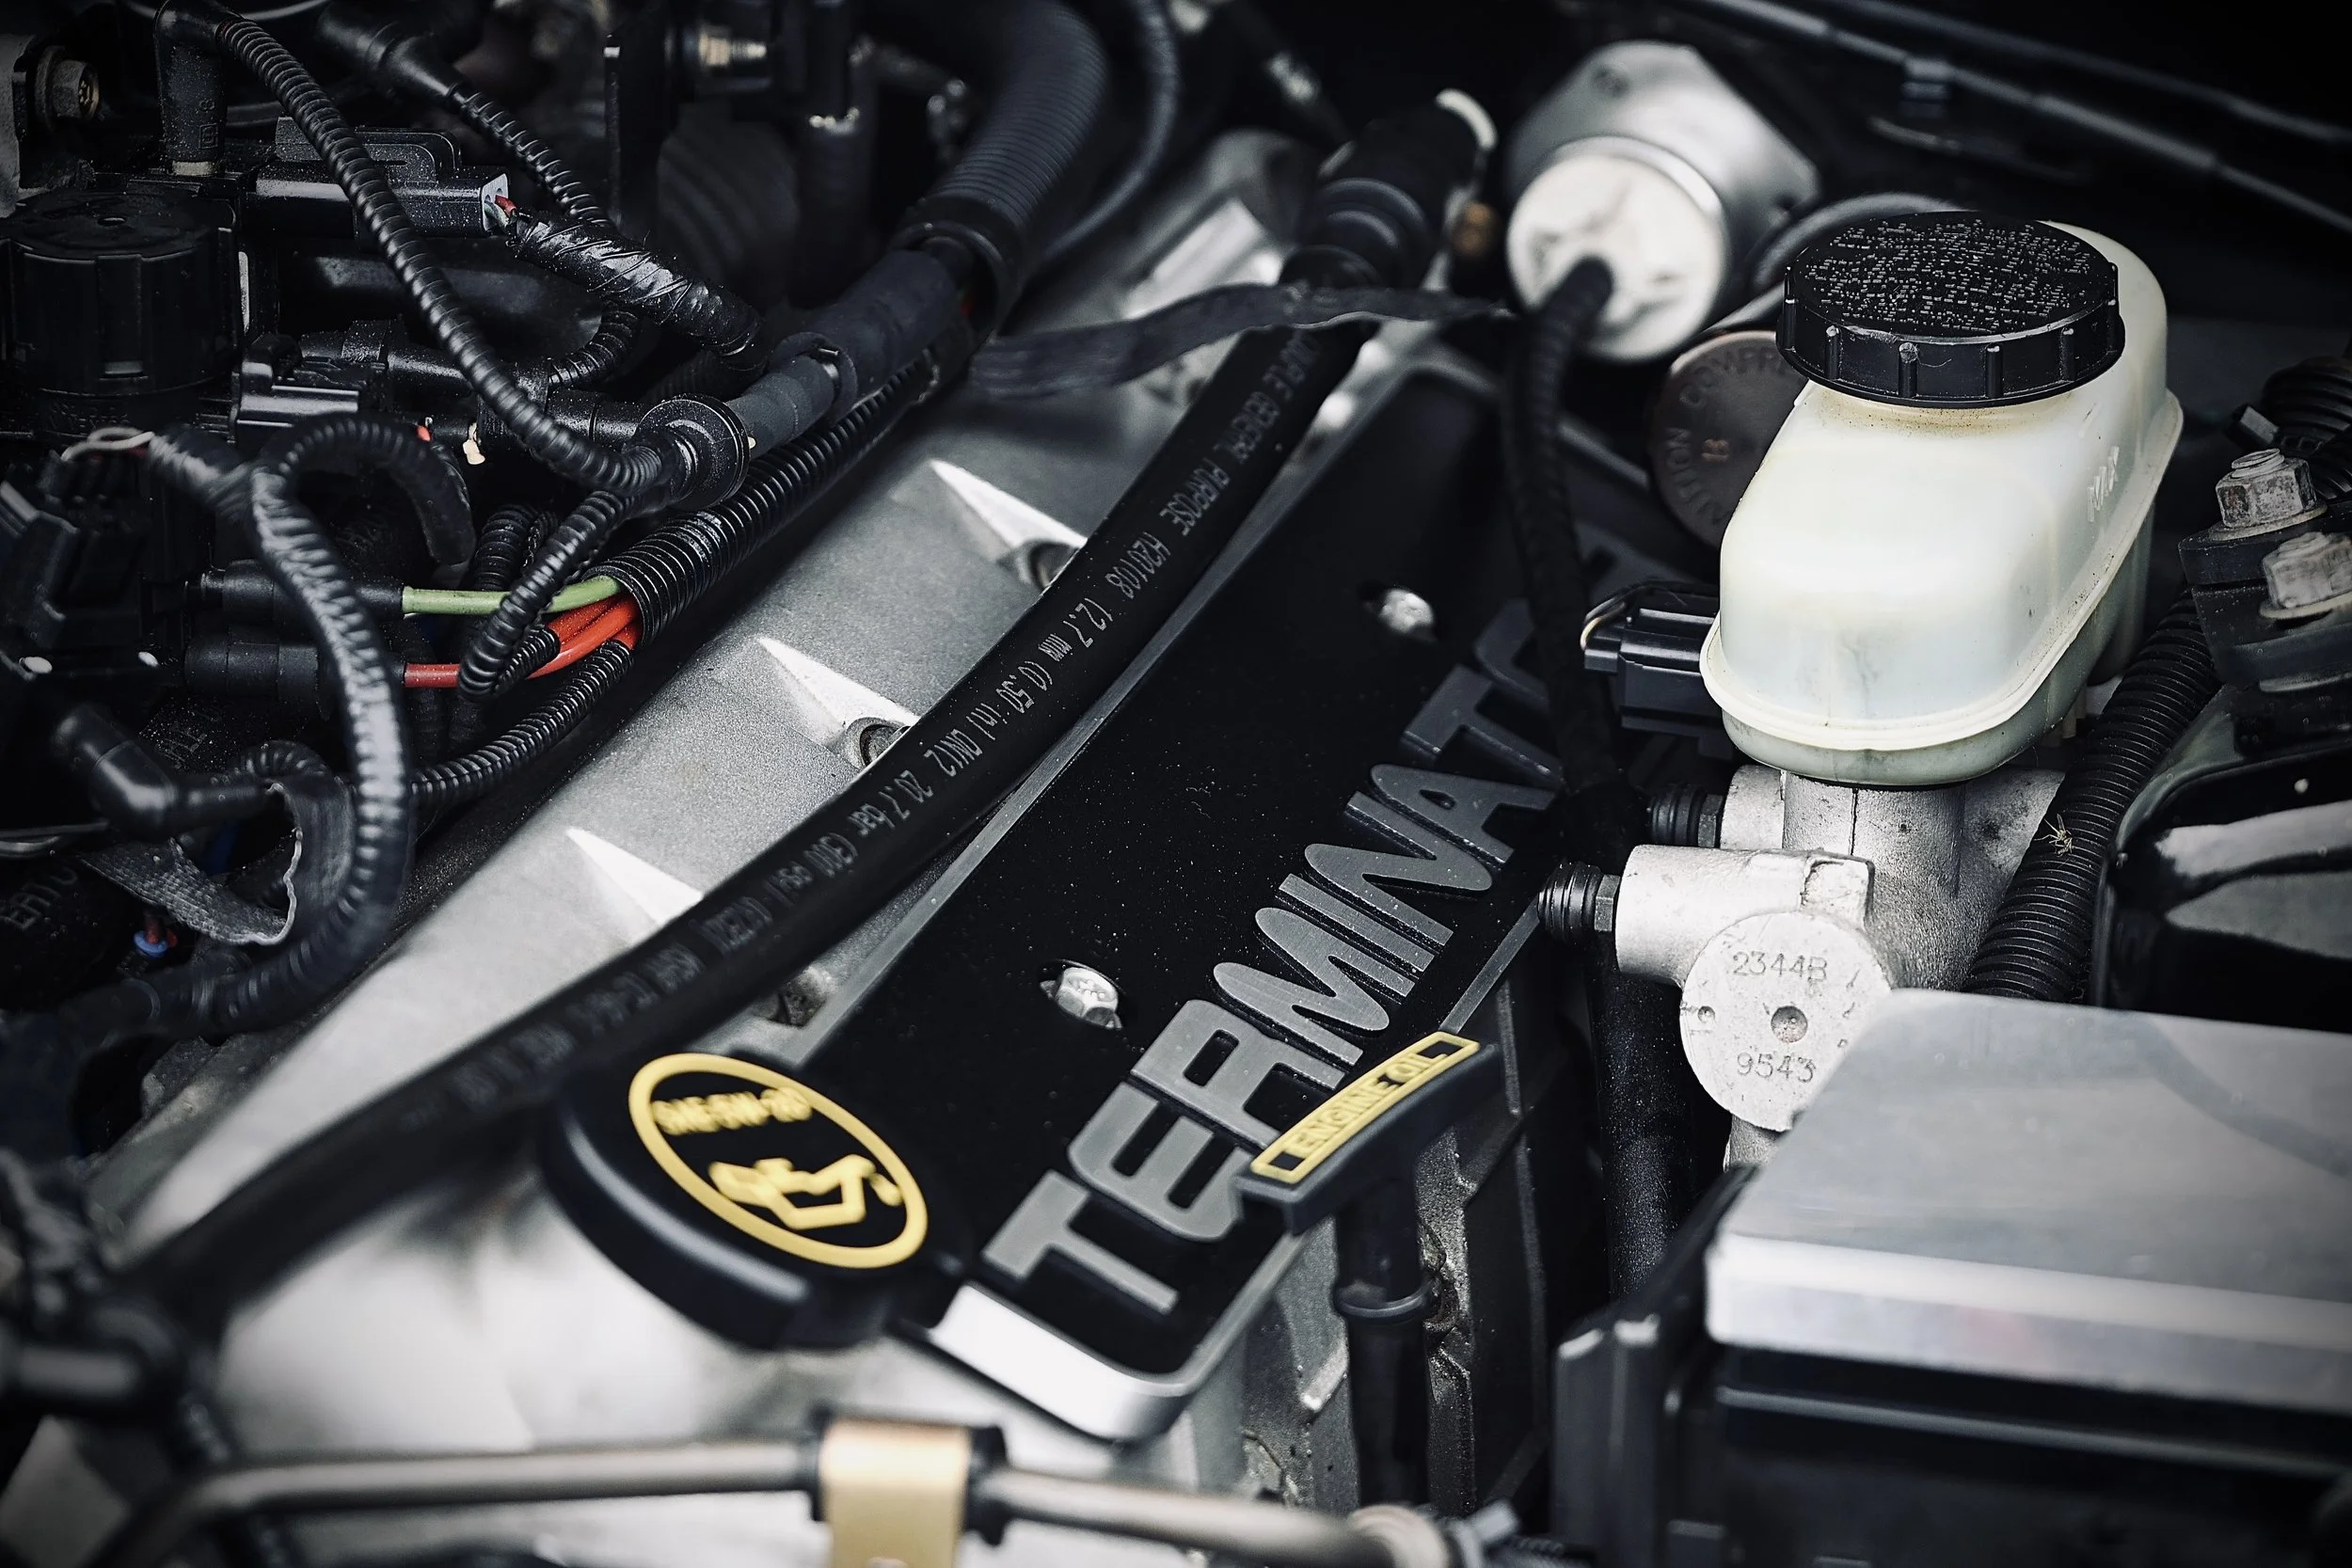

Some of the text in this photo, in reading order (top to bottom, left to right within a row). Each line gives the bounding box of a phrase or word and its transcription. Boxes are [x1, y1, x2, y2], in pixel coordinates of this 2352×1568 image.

[1159, 457, 1231, 537] PURPOSE
[1062, 597, 1115, 648] 12.7
[848, 804, 895, 835] bar
[1733, 950, 1828, 983] 2344B
[1286, 1052, 1449, 1157] ENGINE OIL
